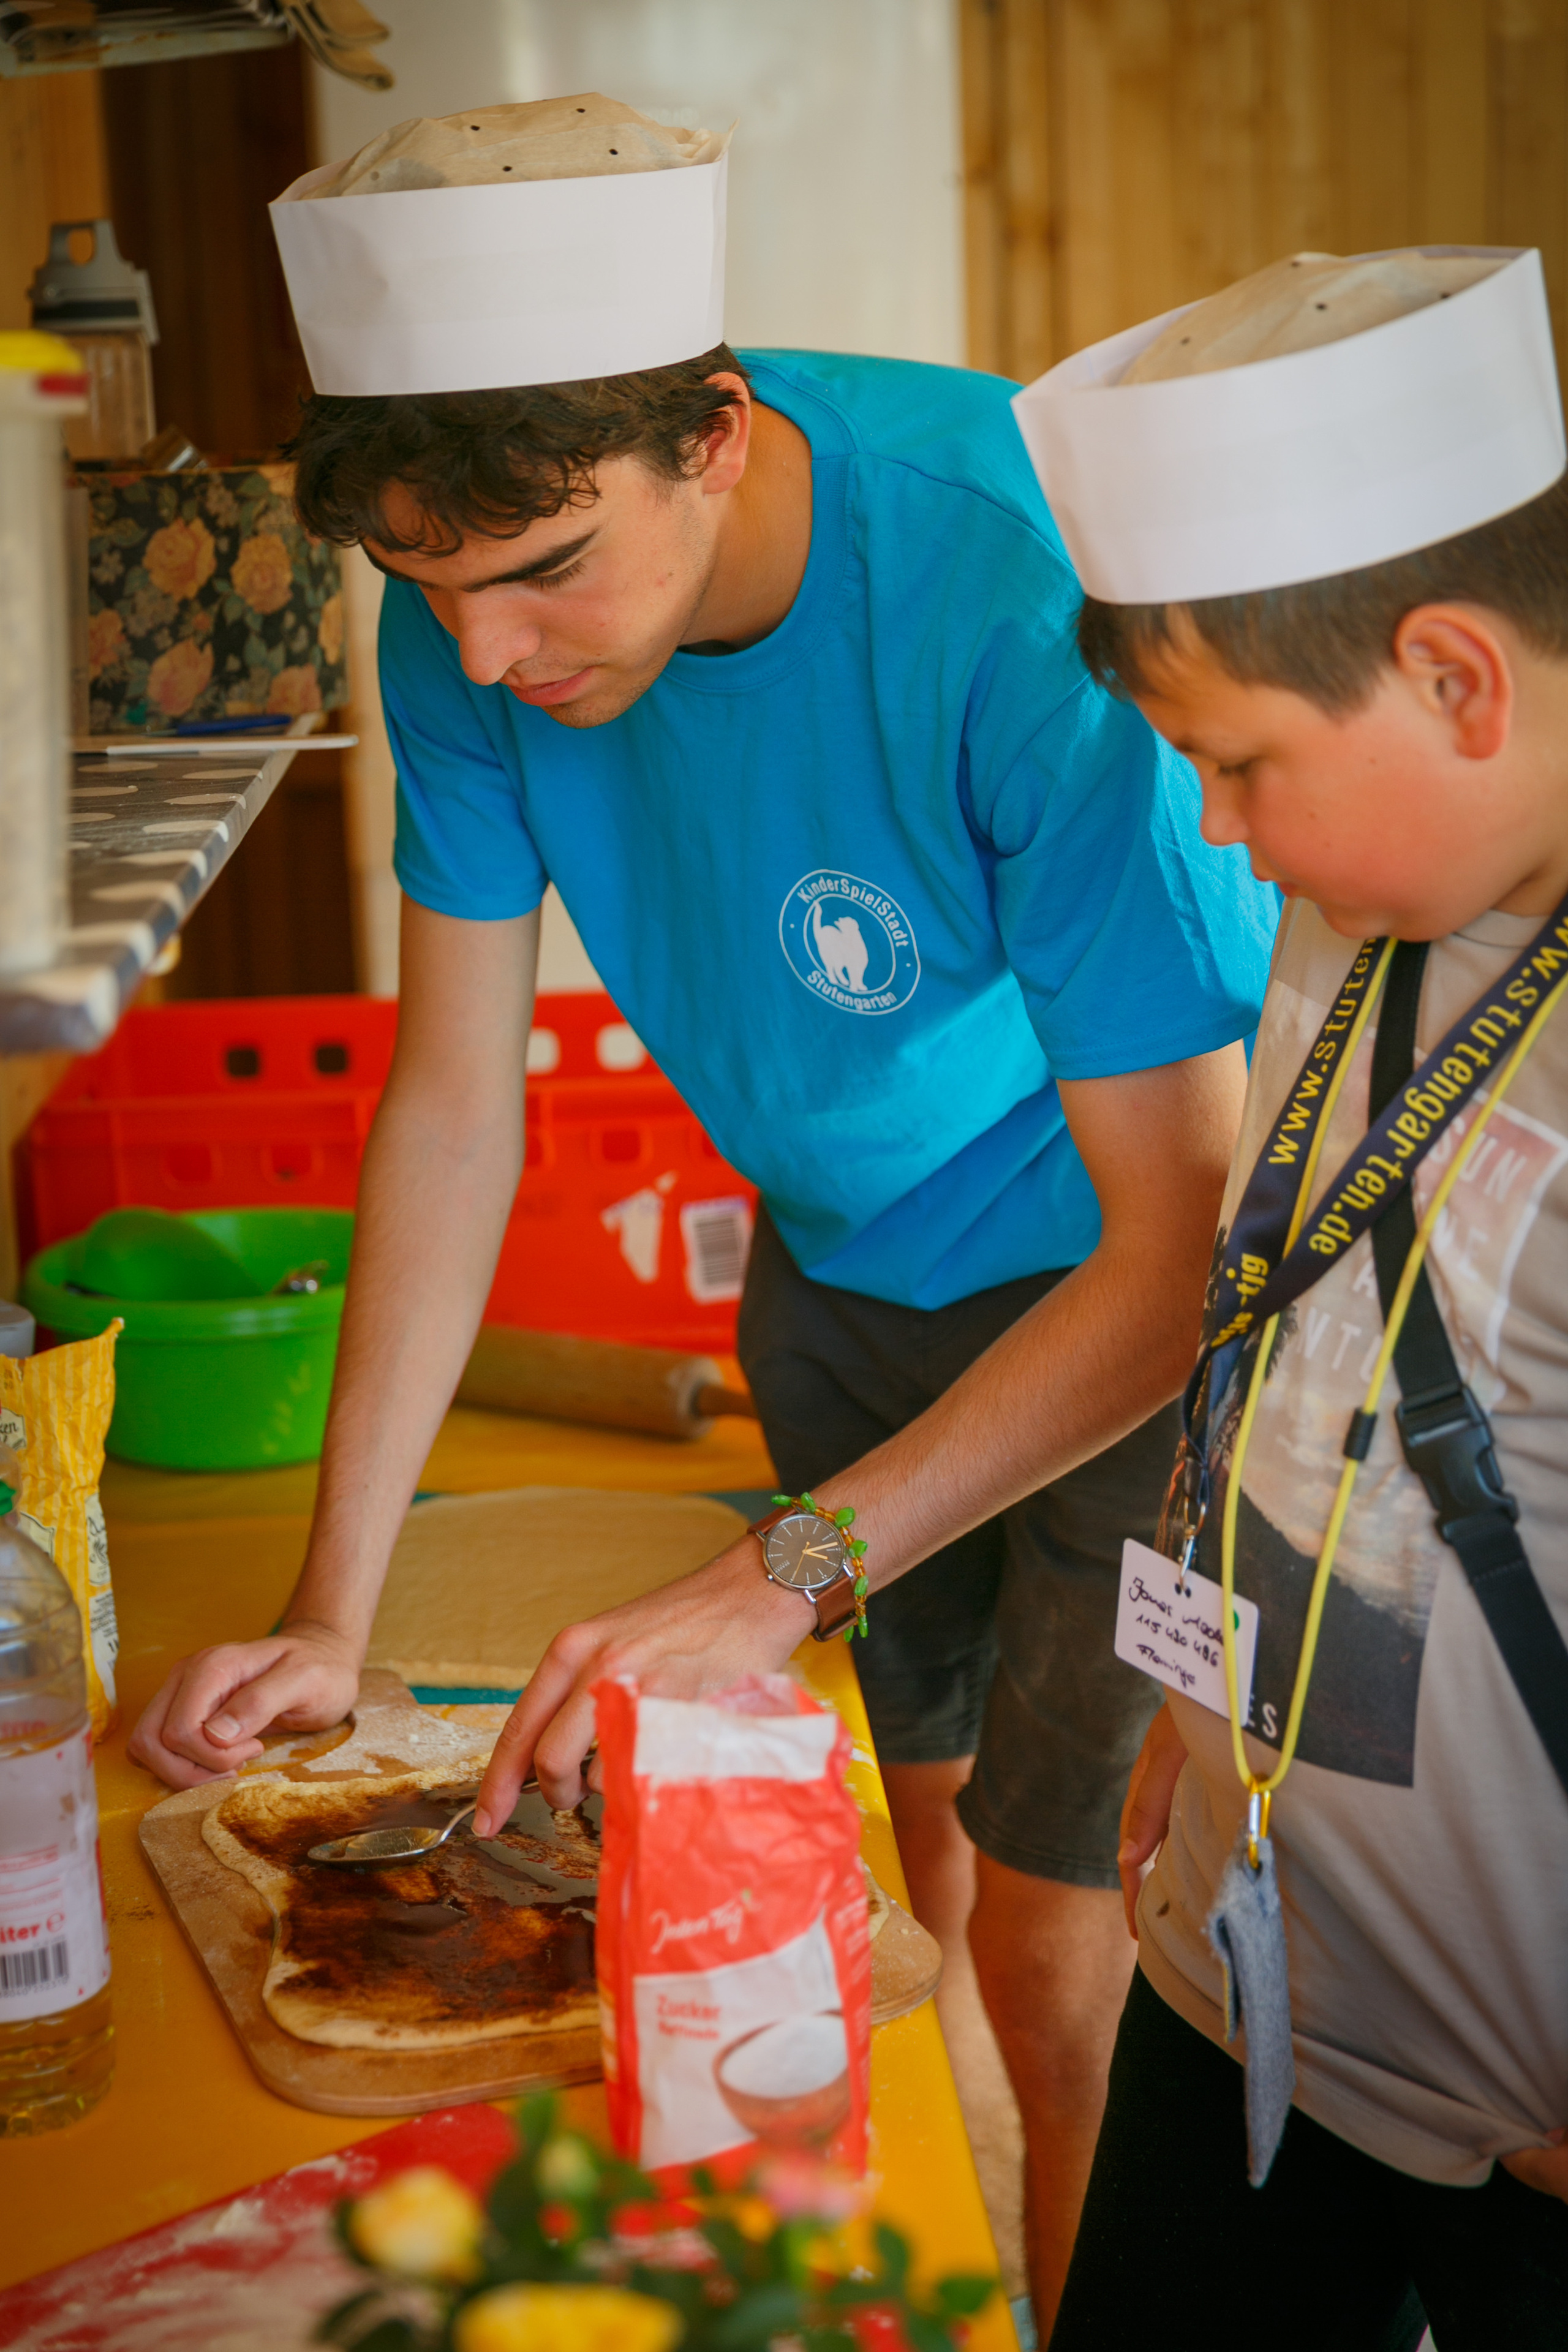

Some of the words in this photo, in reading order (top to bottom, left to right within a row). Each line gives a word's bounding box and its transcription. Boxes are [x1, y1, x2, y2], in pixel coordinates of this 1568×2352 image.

[797, 876, 909, 948] KinderSpielStadt
[807, 970, 897, 1011] Stutengarten
[657, 1995, 722, 2020] Zucker
